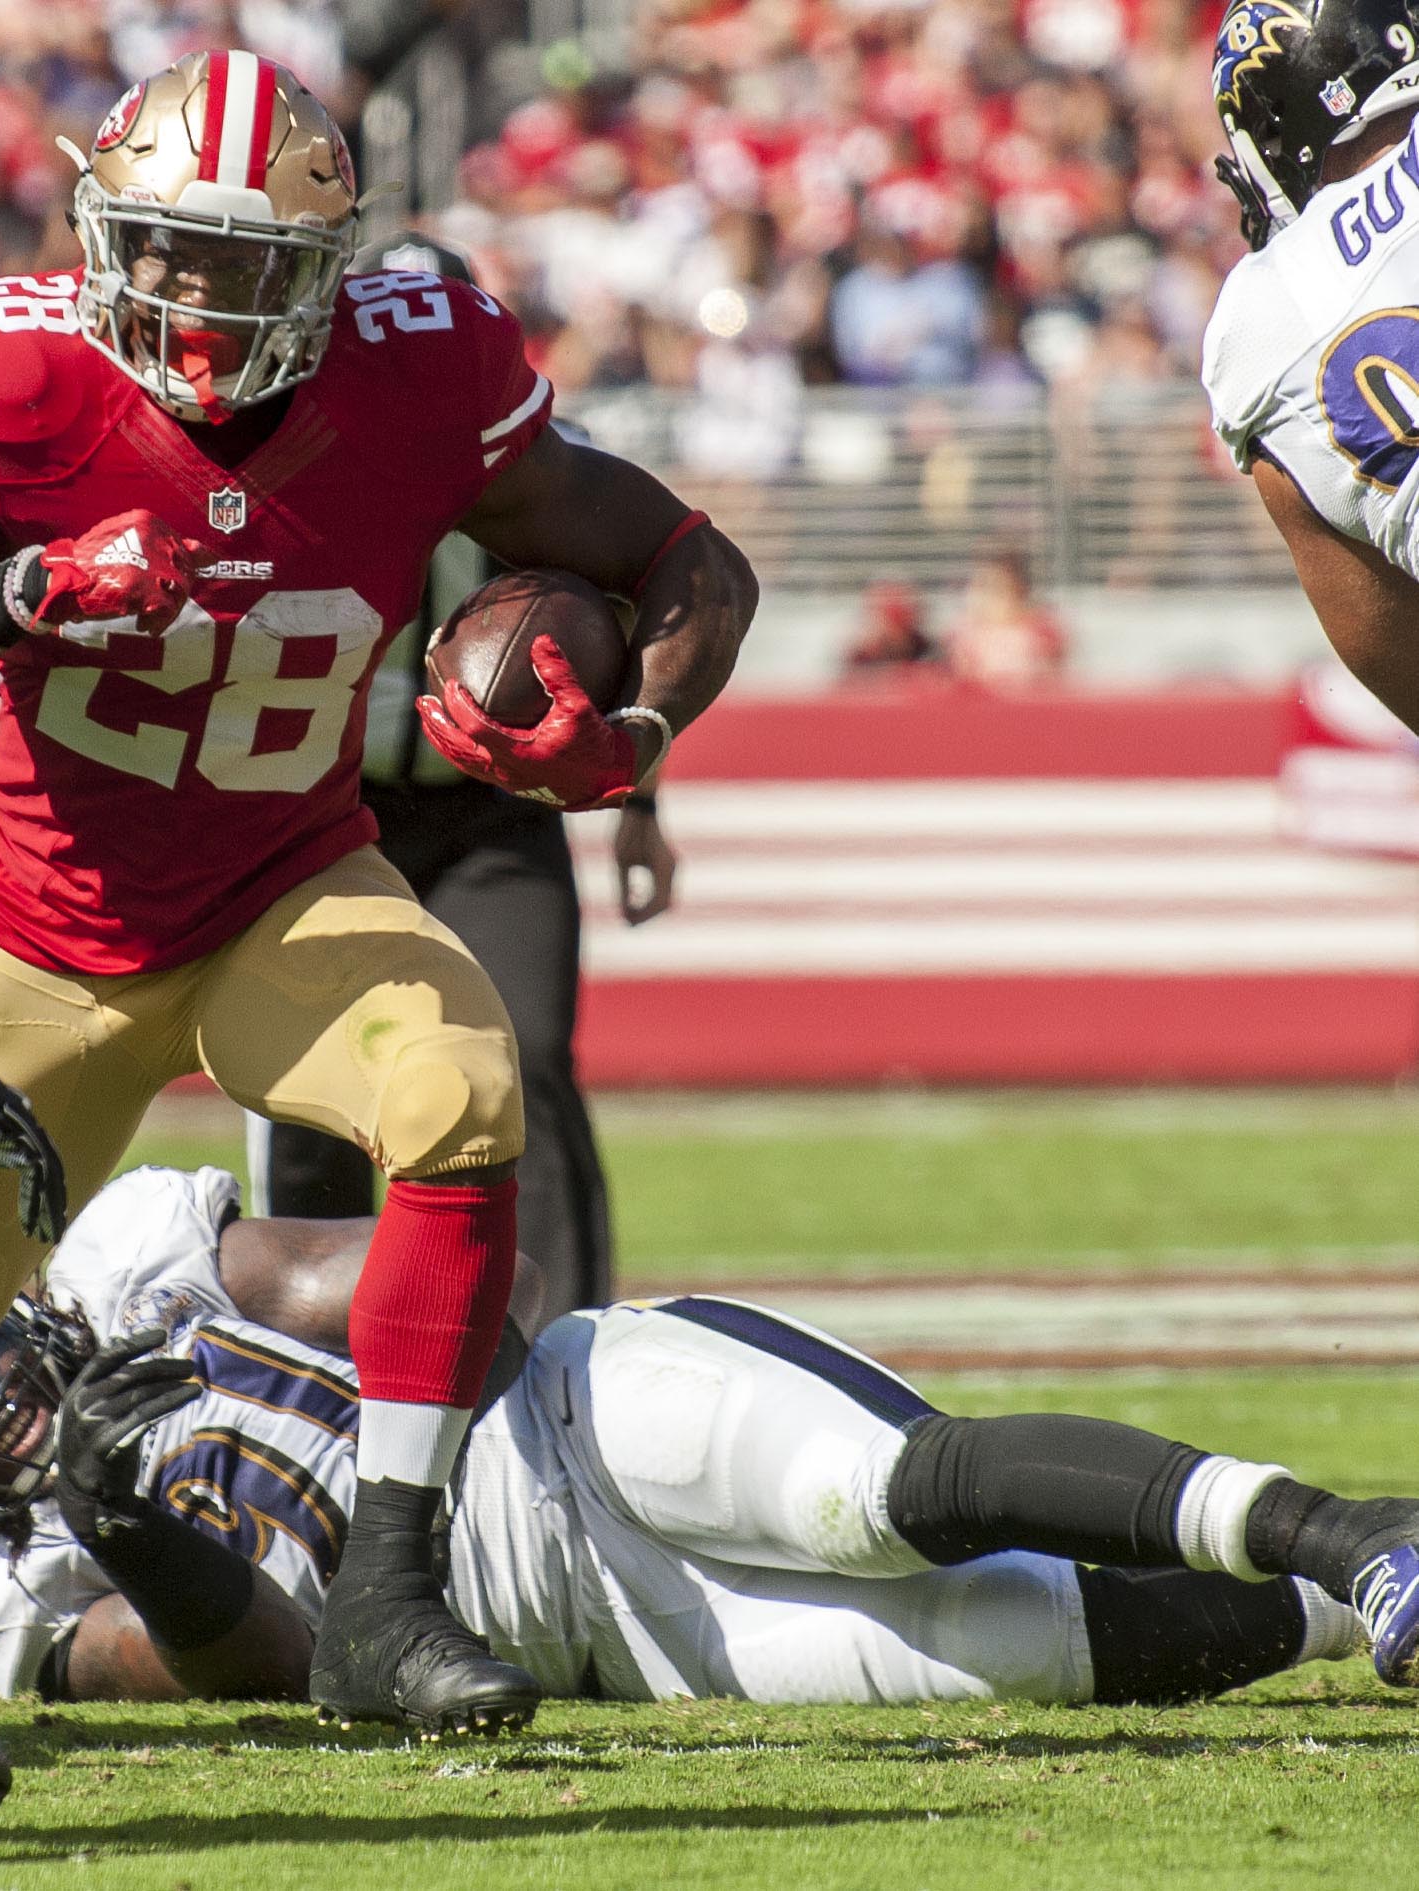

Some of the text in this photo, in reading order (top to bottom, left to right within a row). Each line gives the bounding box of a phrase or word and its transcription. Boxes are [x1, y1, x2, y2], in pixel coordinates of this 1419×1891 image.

[344, 271, 454, 343] 28
[214, 507, 241, 524] NFL
[35, 586, 384, 794] 28
